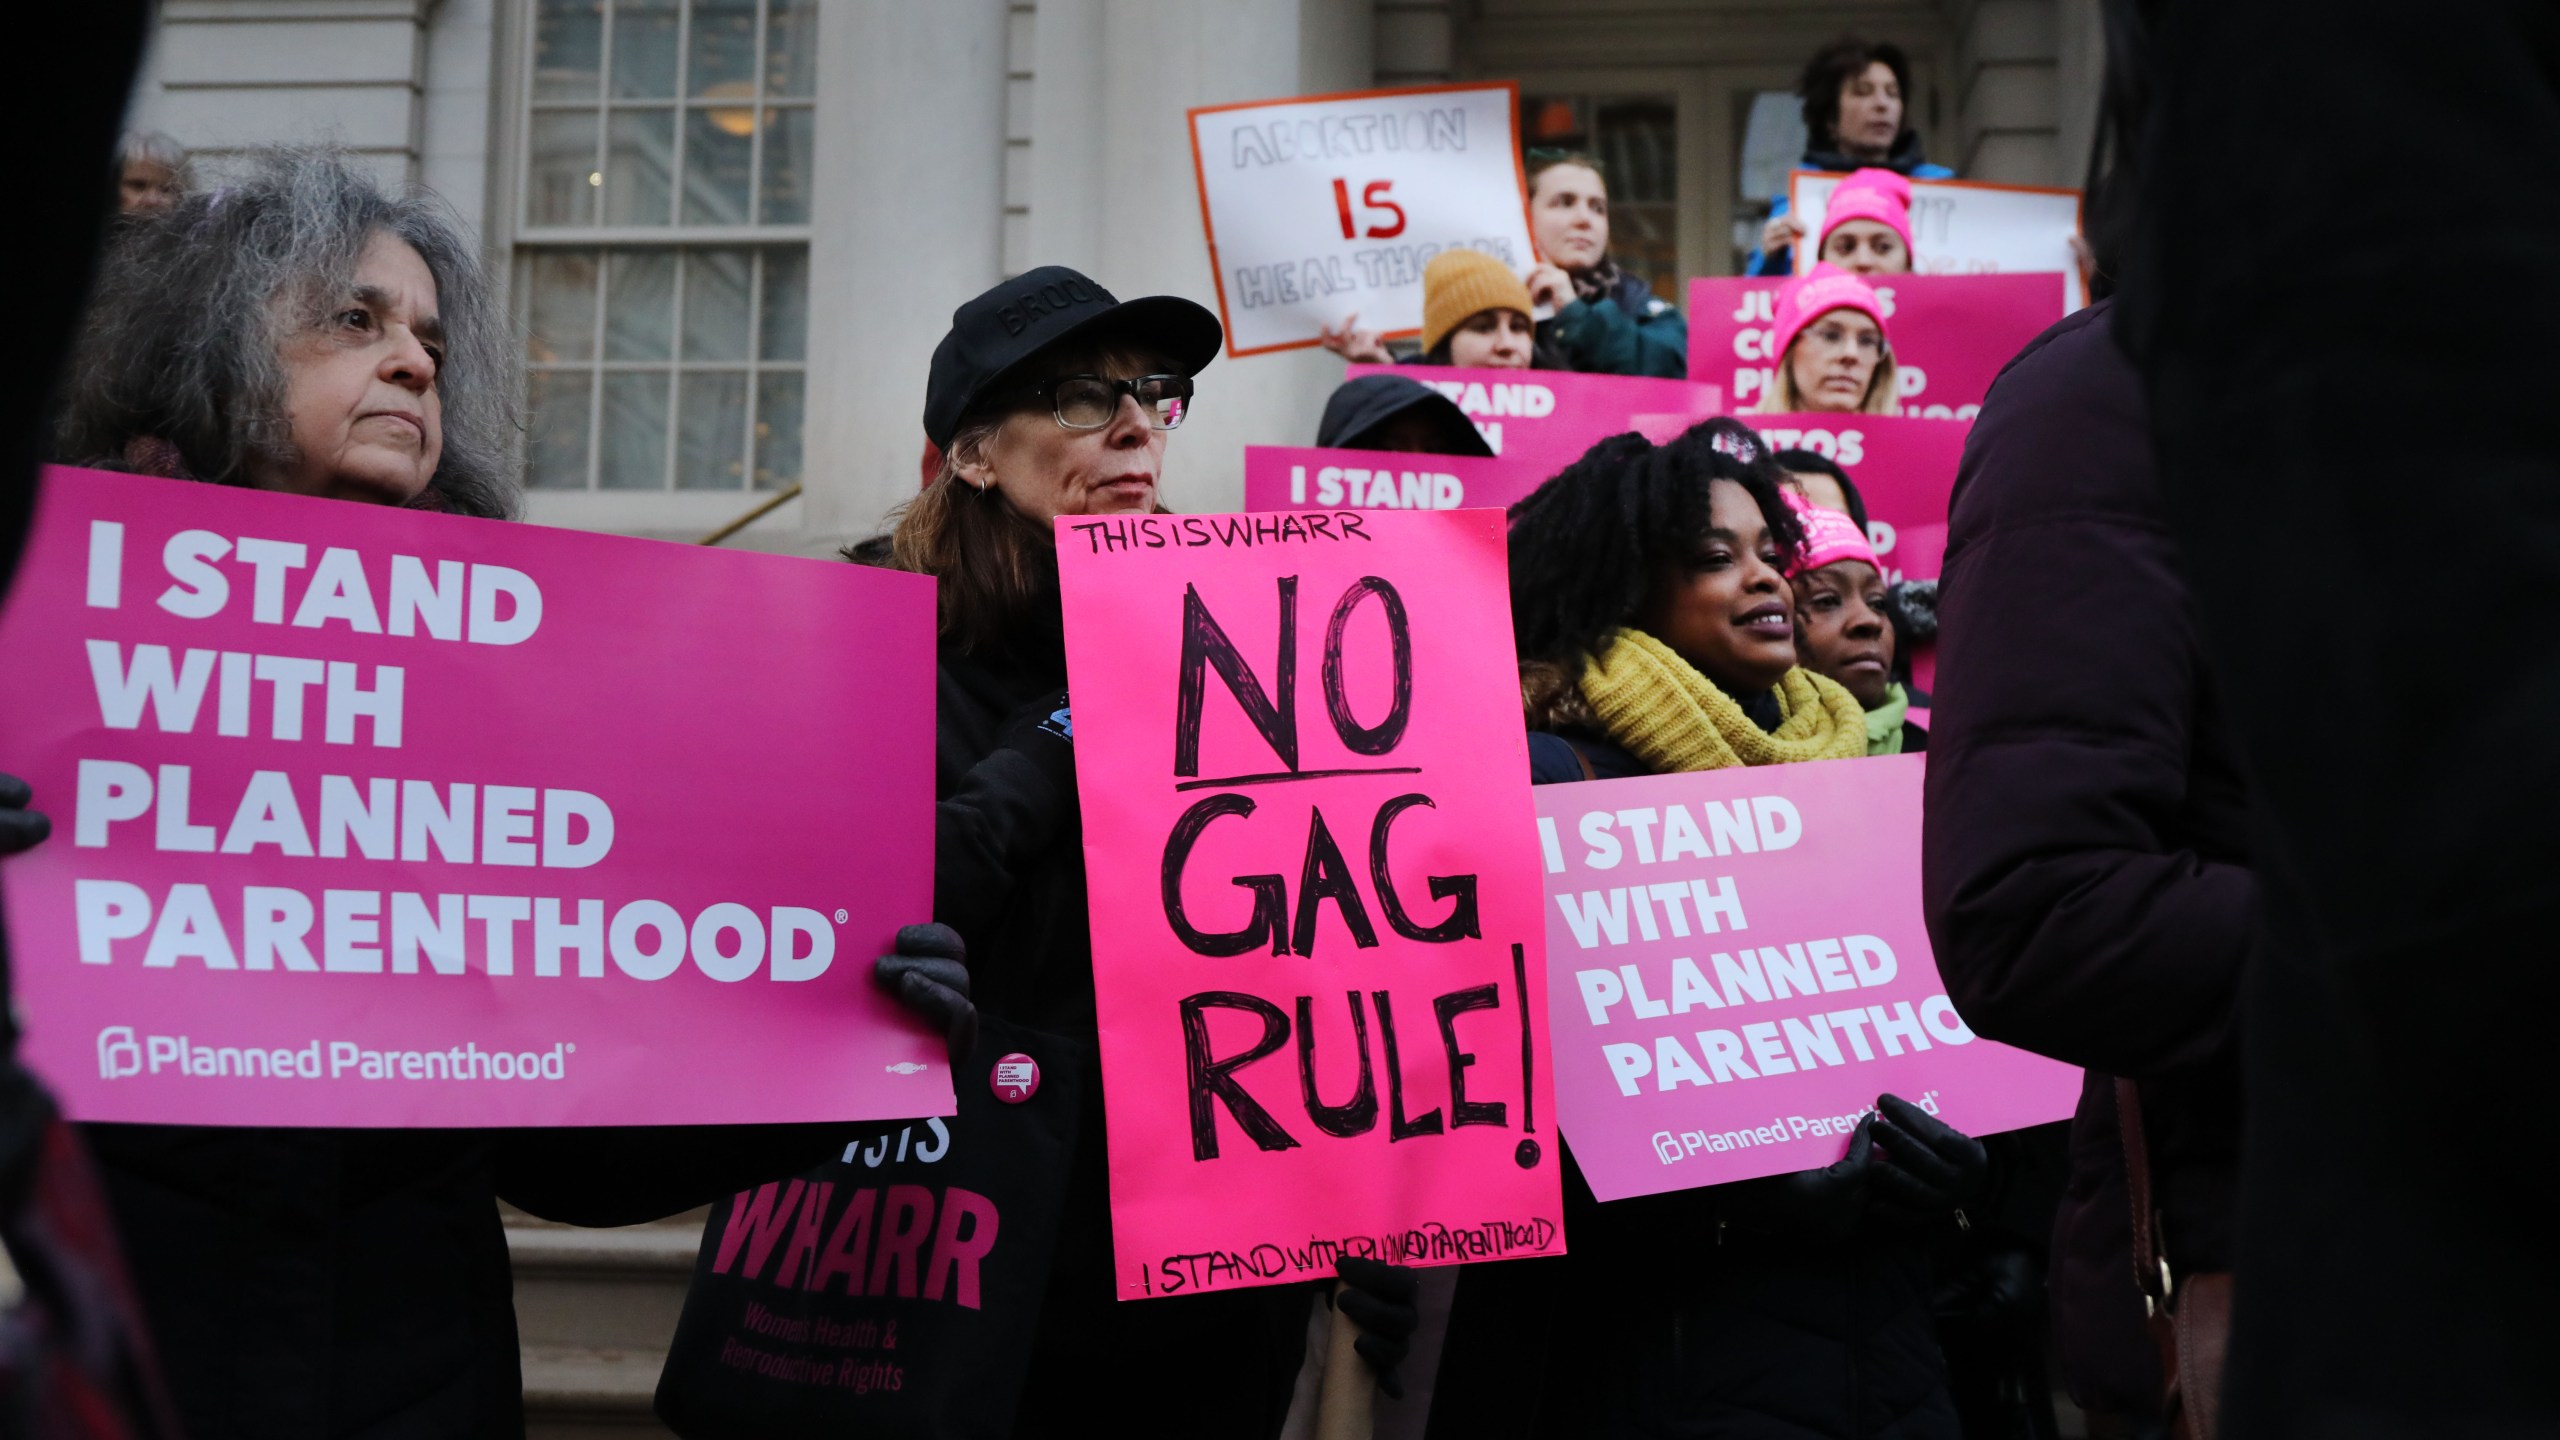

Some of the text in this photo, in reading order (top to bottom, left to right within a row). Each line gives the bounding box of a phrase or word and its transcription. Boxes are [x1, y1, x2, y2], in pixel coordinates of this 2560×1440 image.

[1333, 178, 1407, 240] IS
[1421, 380, 1556, 418] TAND
[1290, 465, 1464, 509] I STAND
[86, 520, 543, 645] I STAND
[85, 639, 405, 748] WITH
[1174, 574, 1413, 778] NO
[75, 758, 616, 869] PLANNED
[1537, 795, 1803, 874] I STAND
[1161, 793, 1481, 959] GAG
[1555, 876, 1748, 949] WITH
[1575, 934, 1898, 1026] PLANNED
[148, 1035, 321, 1079] Planned
[1179, 942, 1541, 1170] RULE!
[1602, 994, 1977, 1097] PARENTHO
[1680, 1118, 1791, 1156] Planned
[712, 1178, 1000, 1311] WHARR
[1142, 1262, 1152, 1296] I
[1161, 1243, 1287, 1294] STAND
[719, 1335, 905, 1396] Reproductive Rights
[813, 1314, 879, 1350] Health
[881, 1317, 897, 1350] &
